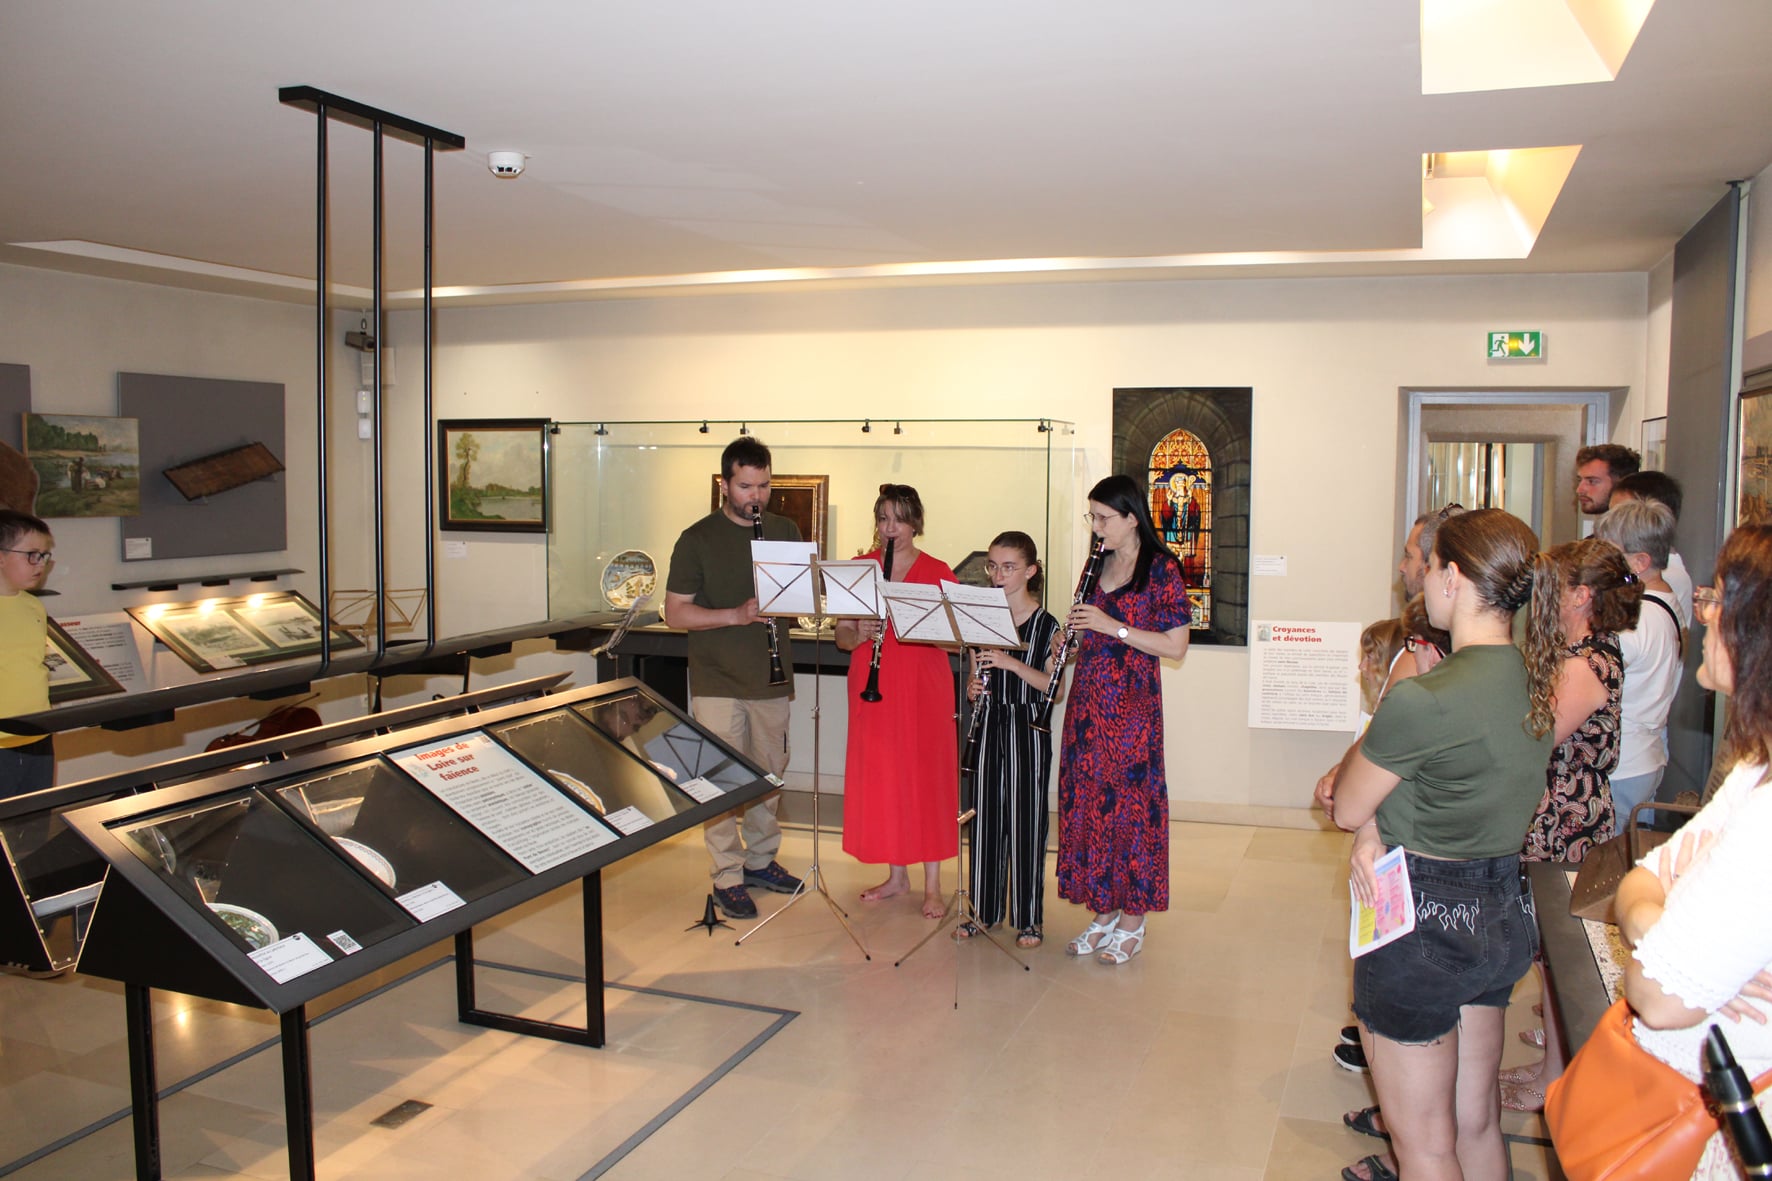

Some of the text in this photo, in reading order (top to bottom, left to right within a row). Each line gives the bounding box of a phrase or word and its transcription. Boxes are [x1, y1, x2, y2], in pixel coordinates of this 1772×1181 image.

[1272, 626, 1316, 634] Croyances
[415, 747, 454, 760] Images
[427, 754, 474, 770] Loire sur
[439, 767, 479, 781] faïence
